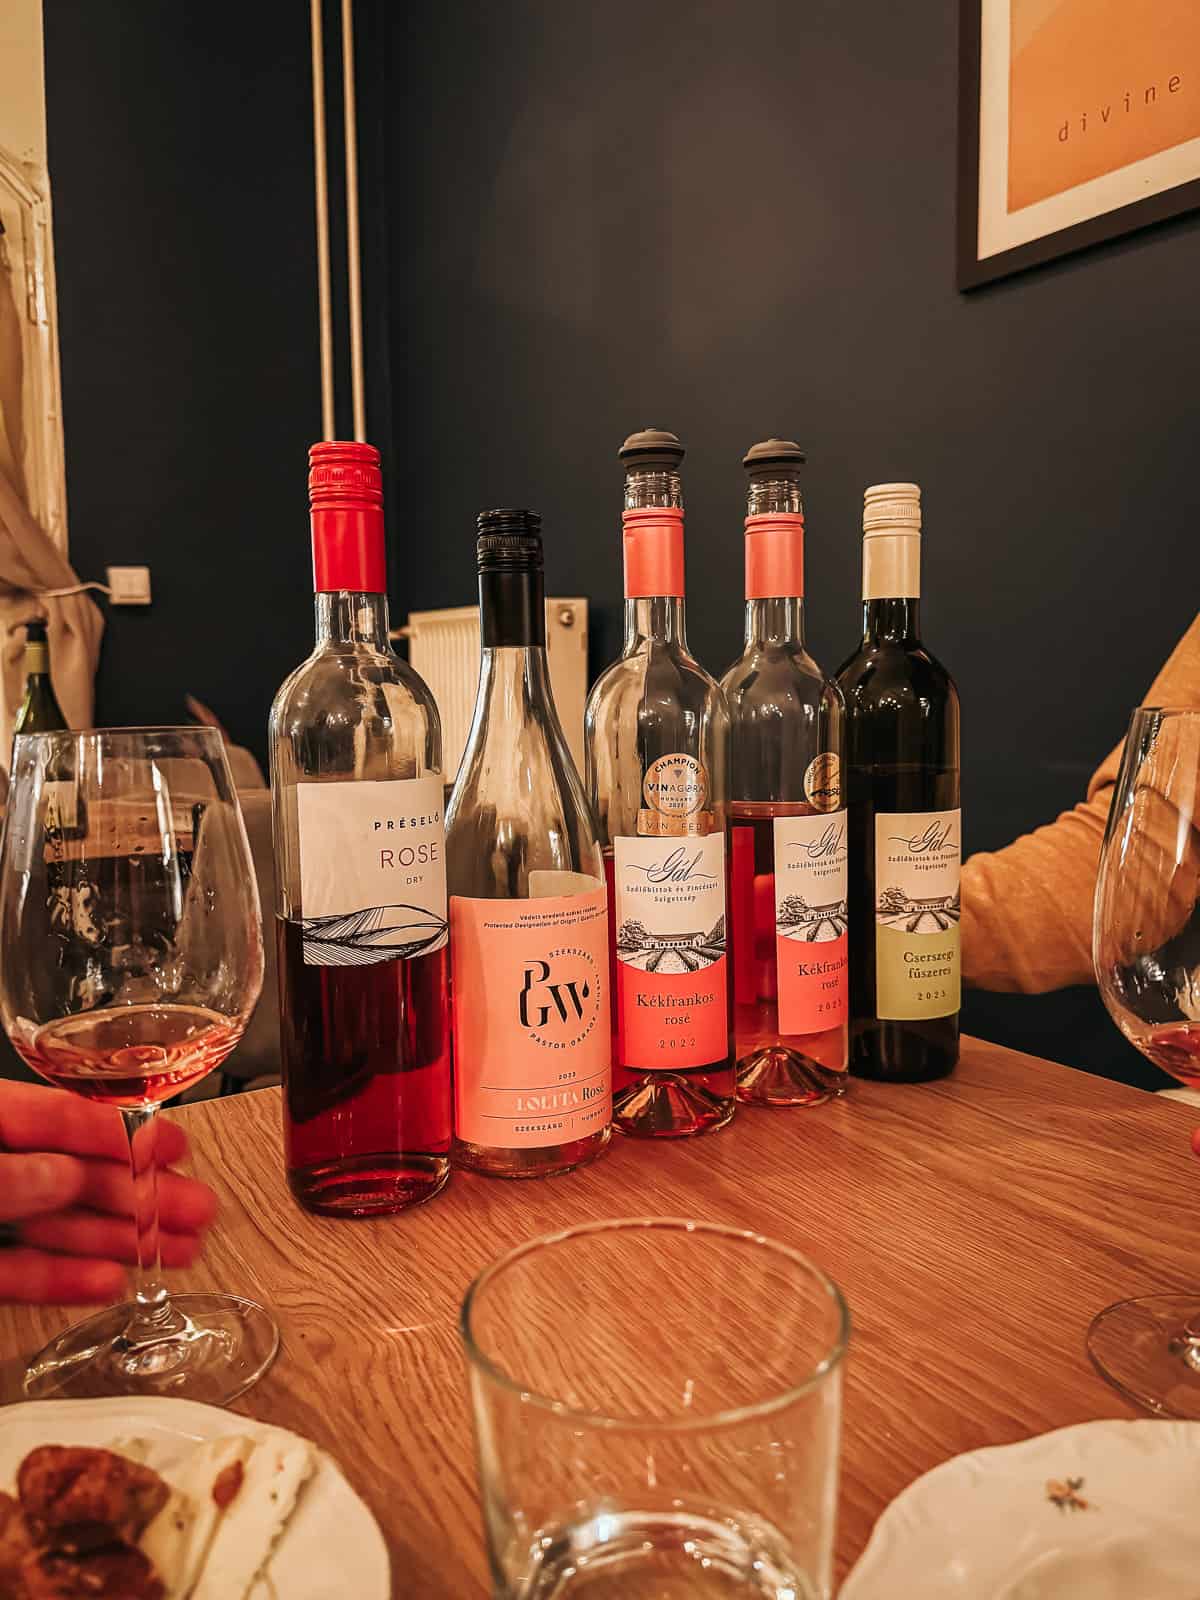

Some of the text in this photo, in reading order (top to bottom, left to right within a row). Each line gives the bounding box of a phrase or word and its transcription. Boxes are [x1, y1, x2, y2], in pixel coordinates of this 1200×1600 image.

[1058, 75, 1181, 142] divine
[654, 757, 702, 775] CHAMPION
[886, 819, 959, 853] Gál
[380, 841, 439, 869] ROSE
[625, 846, 718, 883] Gál
[406, 875, 423, 885] DRY
[636, 993, 715, 1008] Kékfrankos
[663, 1012, 692, 1025] rosé
[657, 1037, 696, 1049] 2022
[515, 1090, 579, 1113] LOLITA
